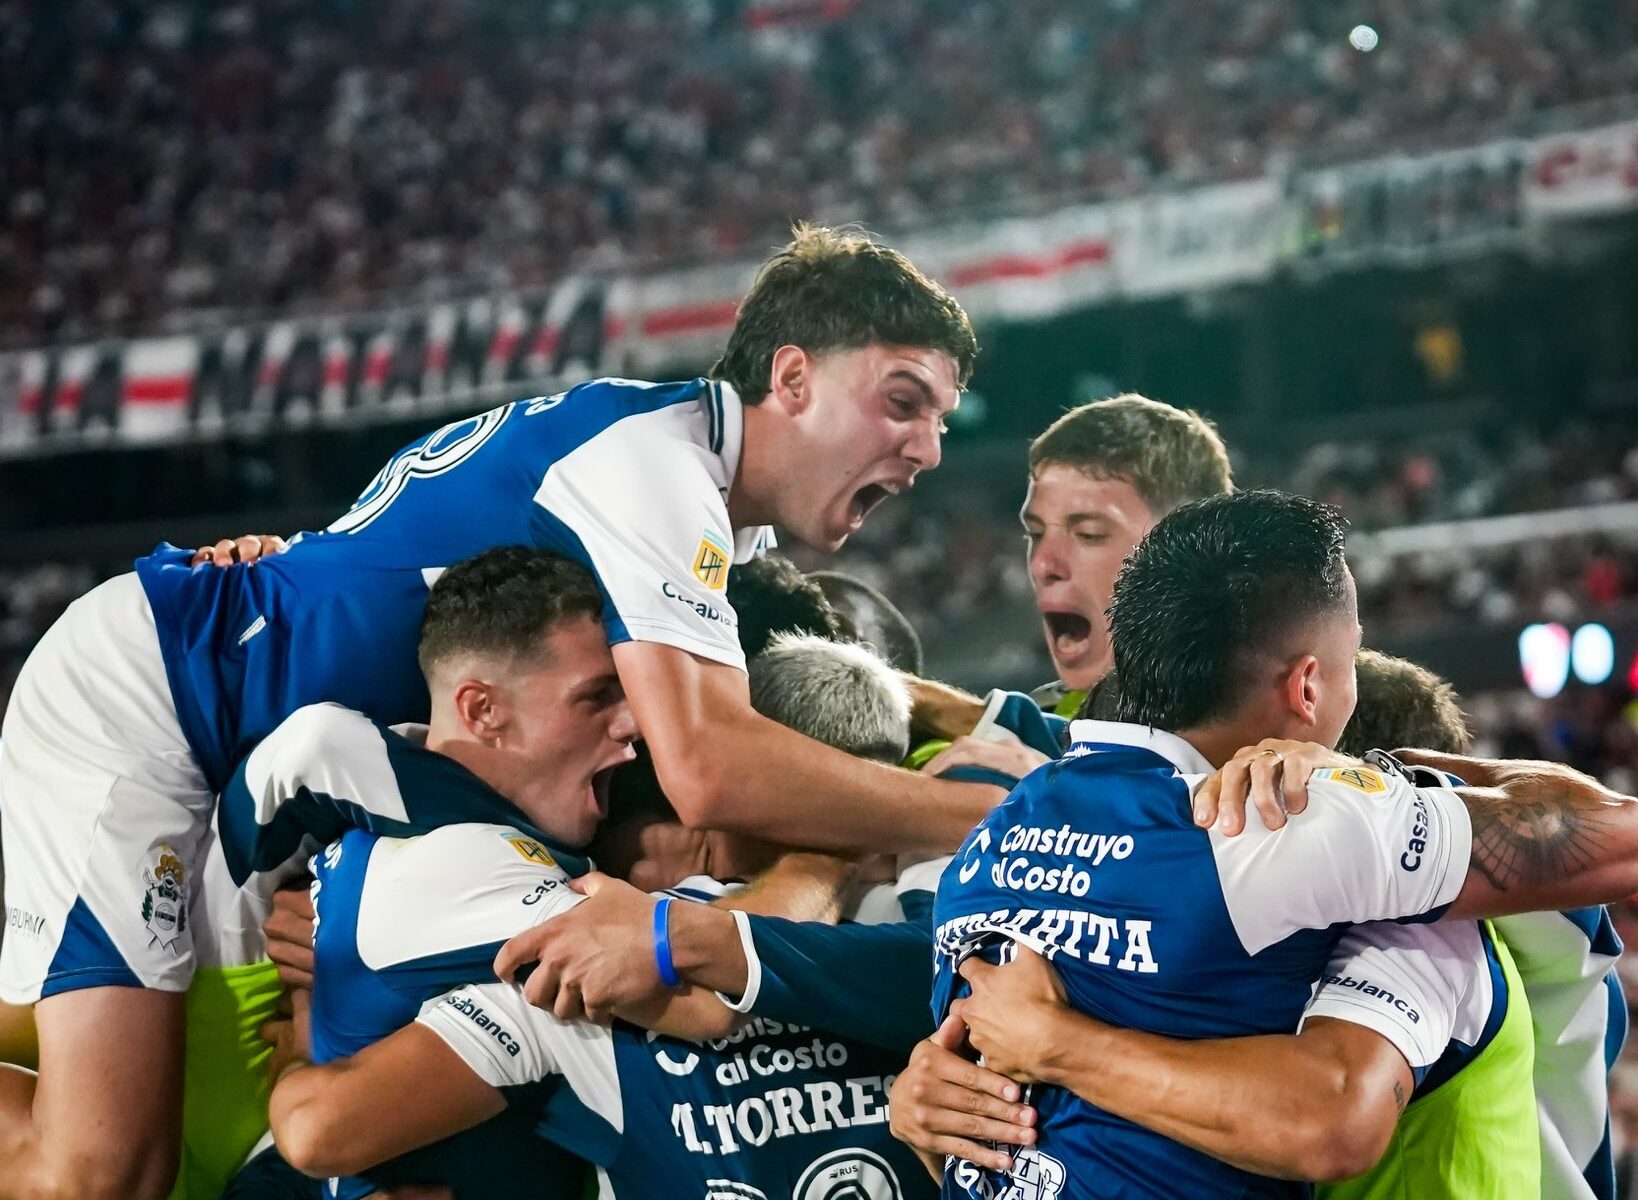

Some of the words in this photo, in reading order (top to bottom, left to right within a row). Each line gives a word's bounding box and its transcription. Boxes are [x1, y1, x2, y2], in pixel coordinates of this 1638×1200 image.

[1000, 824, 1134, 866] Construyo
[715, 1053, 750, 1086] al
[750, 1037, 848, 1076] Costo
[839, 1164, 859, 1177] RUS
